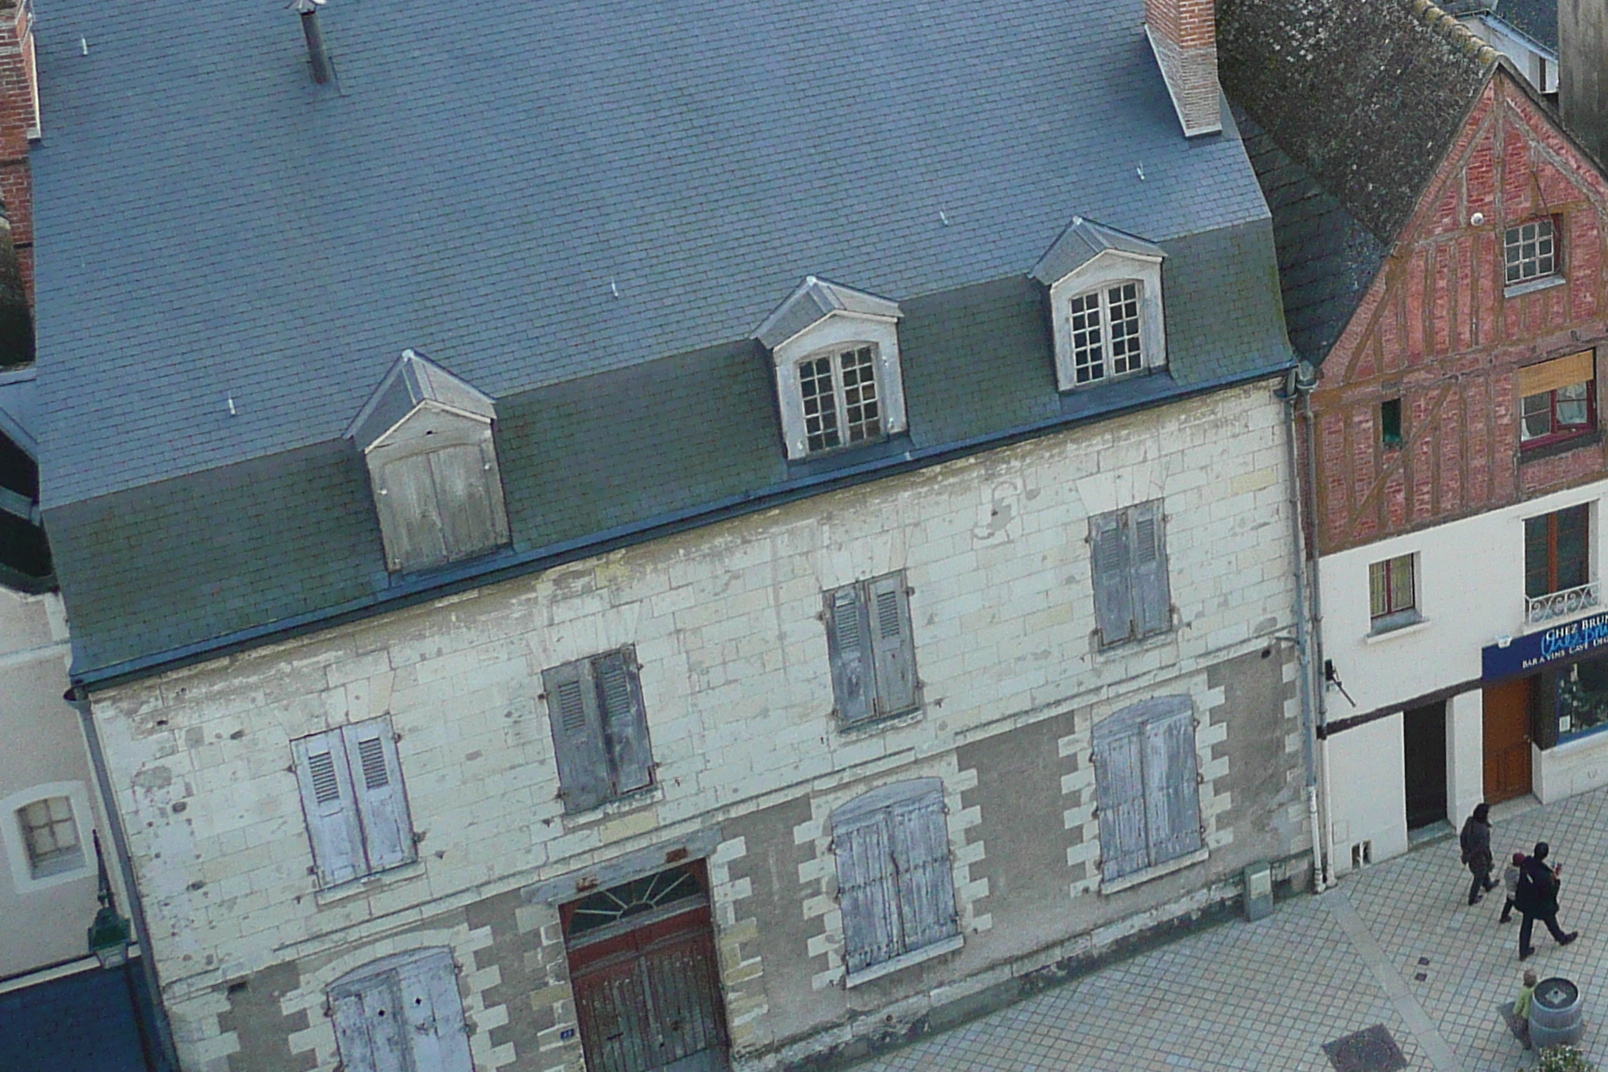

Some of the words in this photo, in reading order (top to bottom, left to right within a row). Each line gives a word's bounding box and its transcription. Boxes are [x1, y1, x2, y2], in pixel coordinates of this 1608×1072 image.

[1546, 624, 1578, 641] CHEZ
[1522, 658, 1538, 669] BAR
[1545, 650, 1566, 661] VINS
